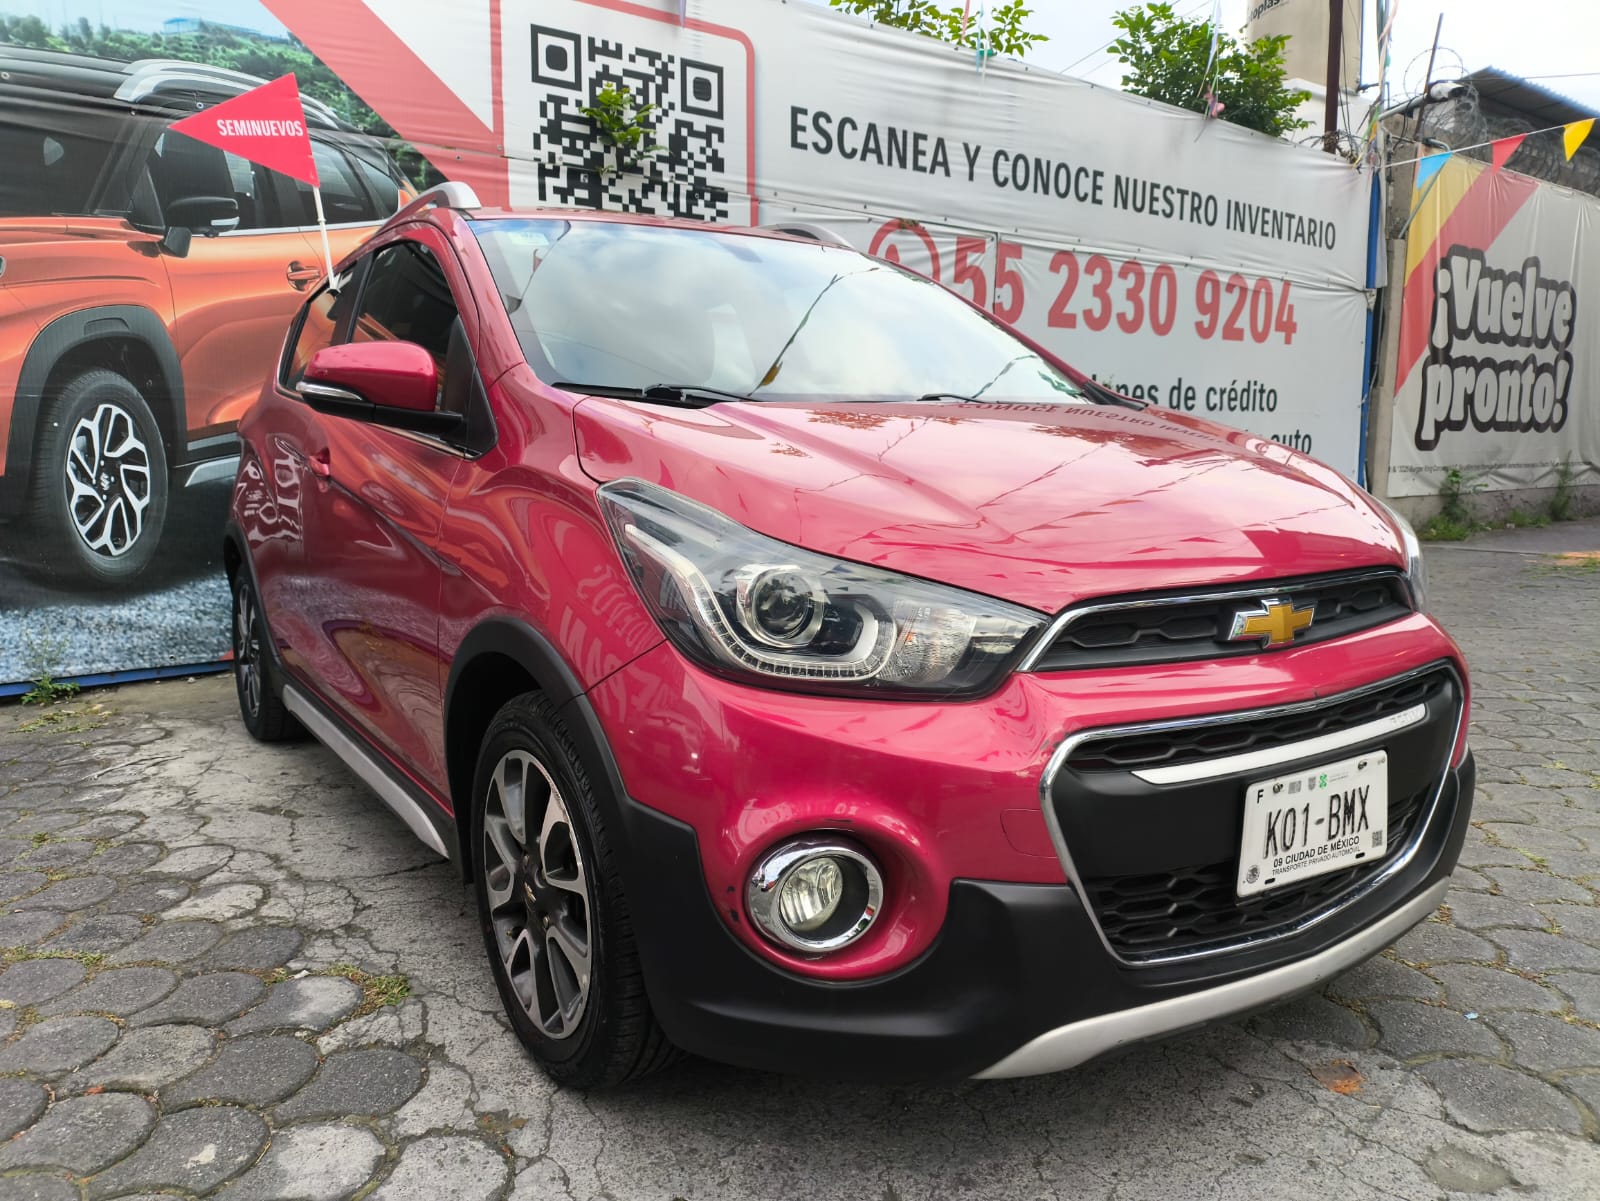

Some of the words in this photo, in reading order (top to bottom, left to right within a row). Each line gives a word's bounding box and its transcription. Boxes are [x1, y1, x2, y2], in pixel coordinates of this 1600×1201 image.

[216, 119, 304, 137] SEMINUEVOS
[790, 105, 951, 178] ESCANEA
[962, 142, 982, 182] Y
[992, 149, 1105, 206] CONOCE
[1113, 174, 1218, 227] NUESTRO
[1226, 199, 1336, 250] INVENTARIO
[953, 236, 1025, 325] 55
[1047, 250, 1178, 337] 2330
[1194, 270, 1298, 345] 9204
[1430, 248, 1575, 350] ¡Vuelve
[1168, 377, 1196, 412] de
[1206, 380, 1278, 413] crédito
[1418, 355, 1572, 446] pronto!
[1256, 789, 1265, 804] F
[1262, 784, 1370, 860] K01-BMX
[1272, 860, 1308, 876] TRANSPORTE
[1308, 853, 1331, 866] PRIVADO
[1273, 857, 1283, 868] 09
[1285, 849, 1316, 864] CIUDAD
[1317, 844, 1328, 856] DE
[1330, 836, 1360, 852] MÉXICO
